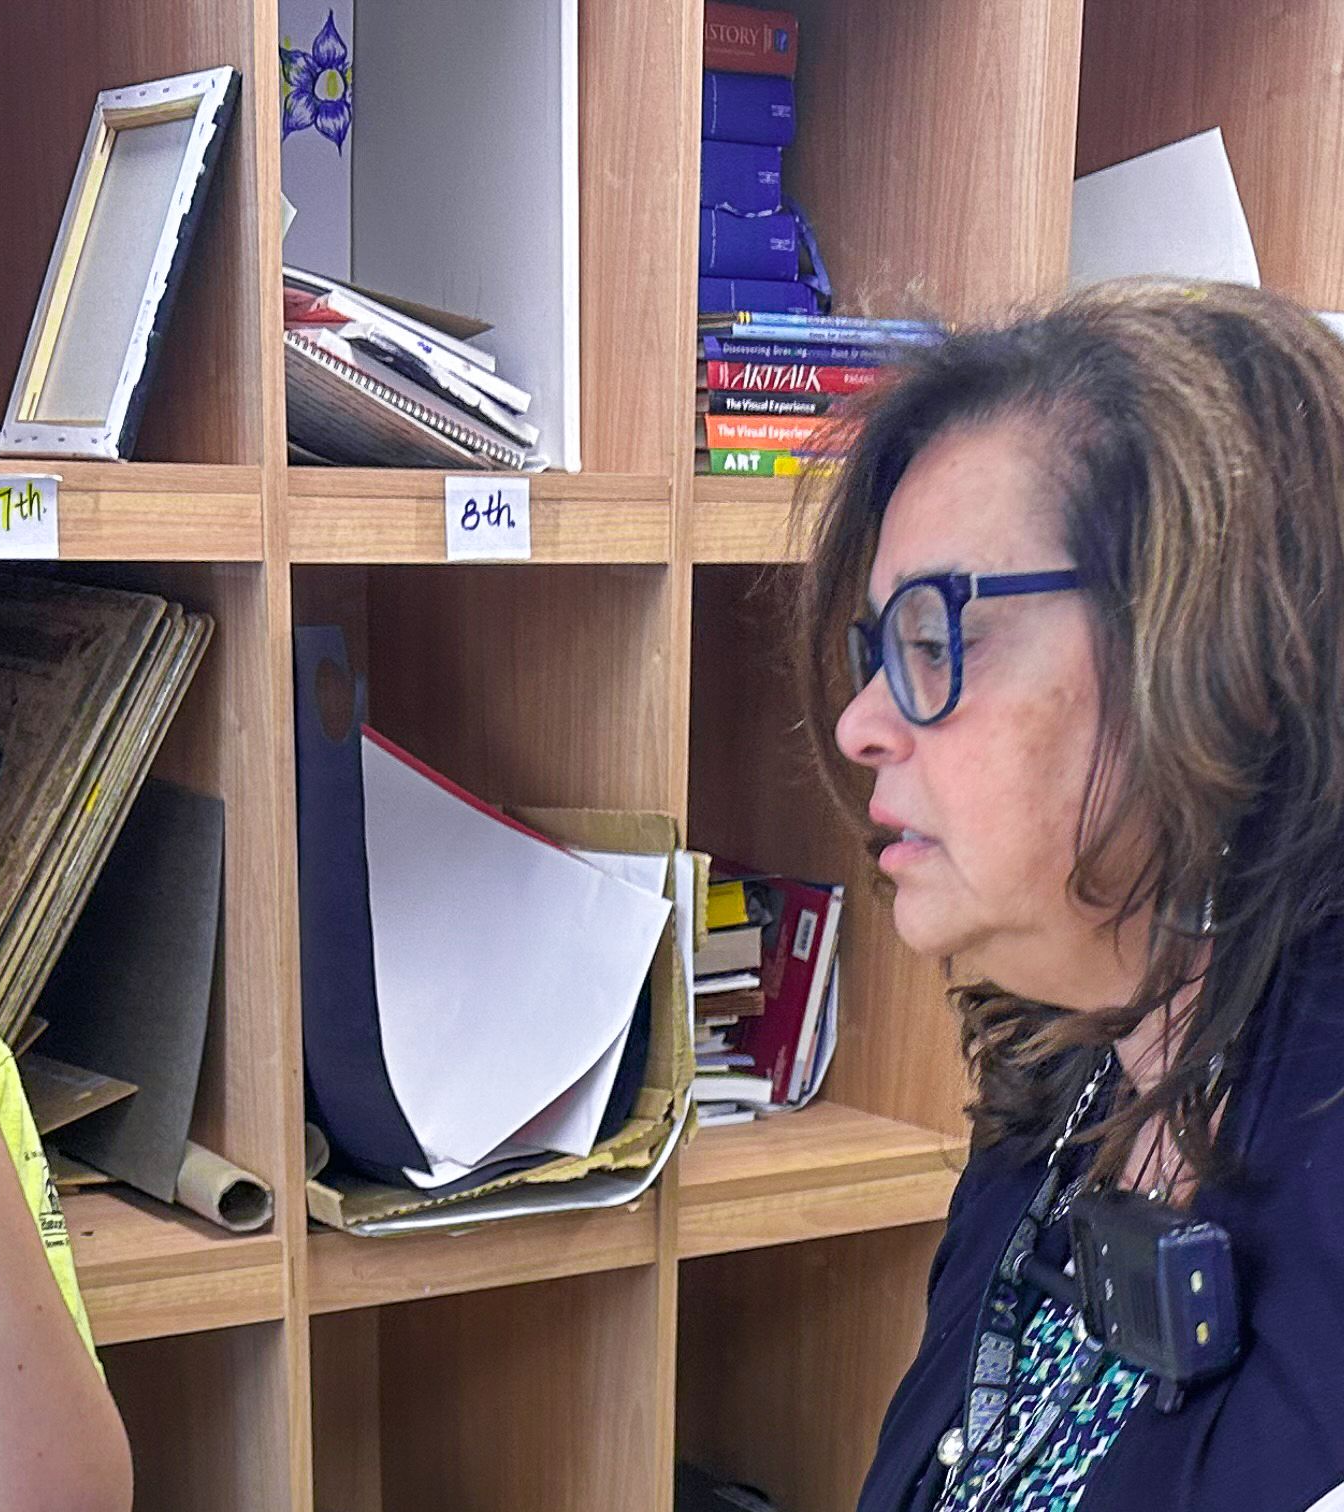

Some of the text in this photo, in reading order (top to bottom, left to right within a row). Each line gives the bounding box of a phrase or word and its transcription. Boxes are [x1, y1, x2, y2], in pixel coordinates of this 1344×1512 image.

[726, 398, 816, 414] The Visual Experience
[718, 424, 813, 442] The Visual Experien
[724, 453, 761, 471] ART
[460, 490, 516, 531] 8th.
